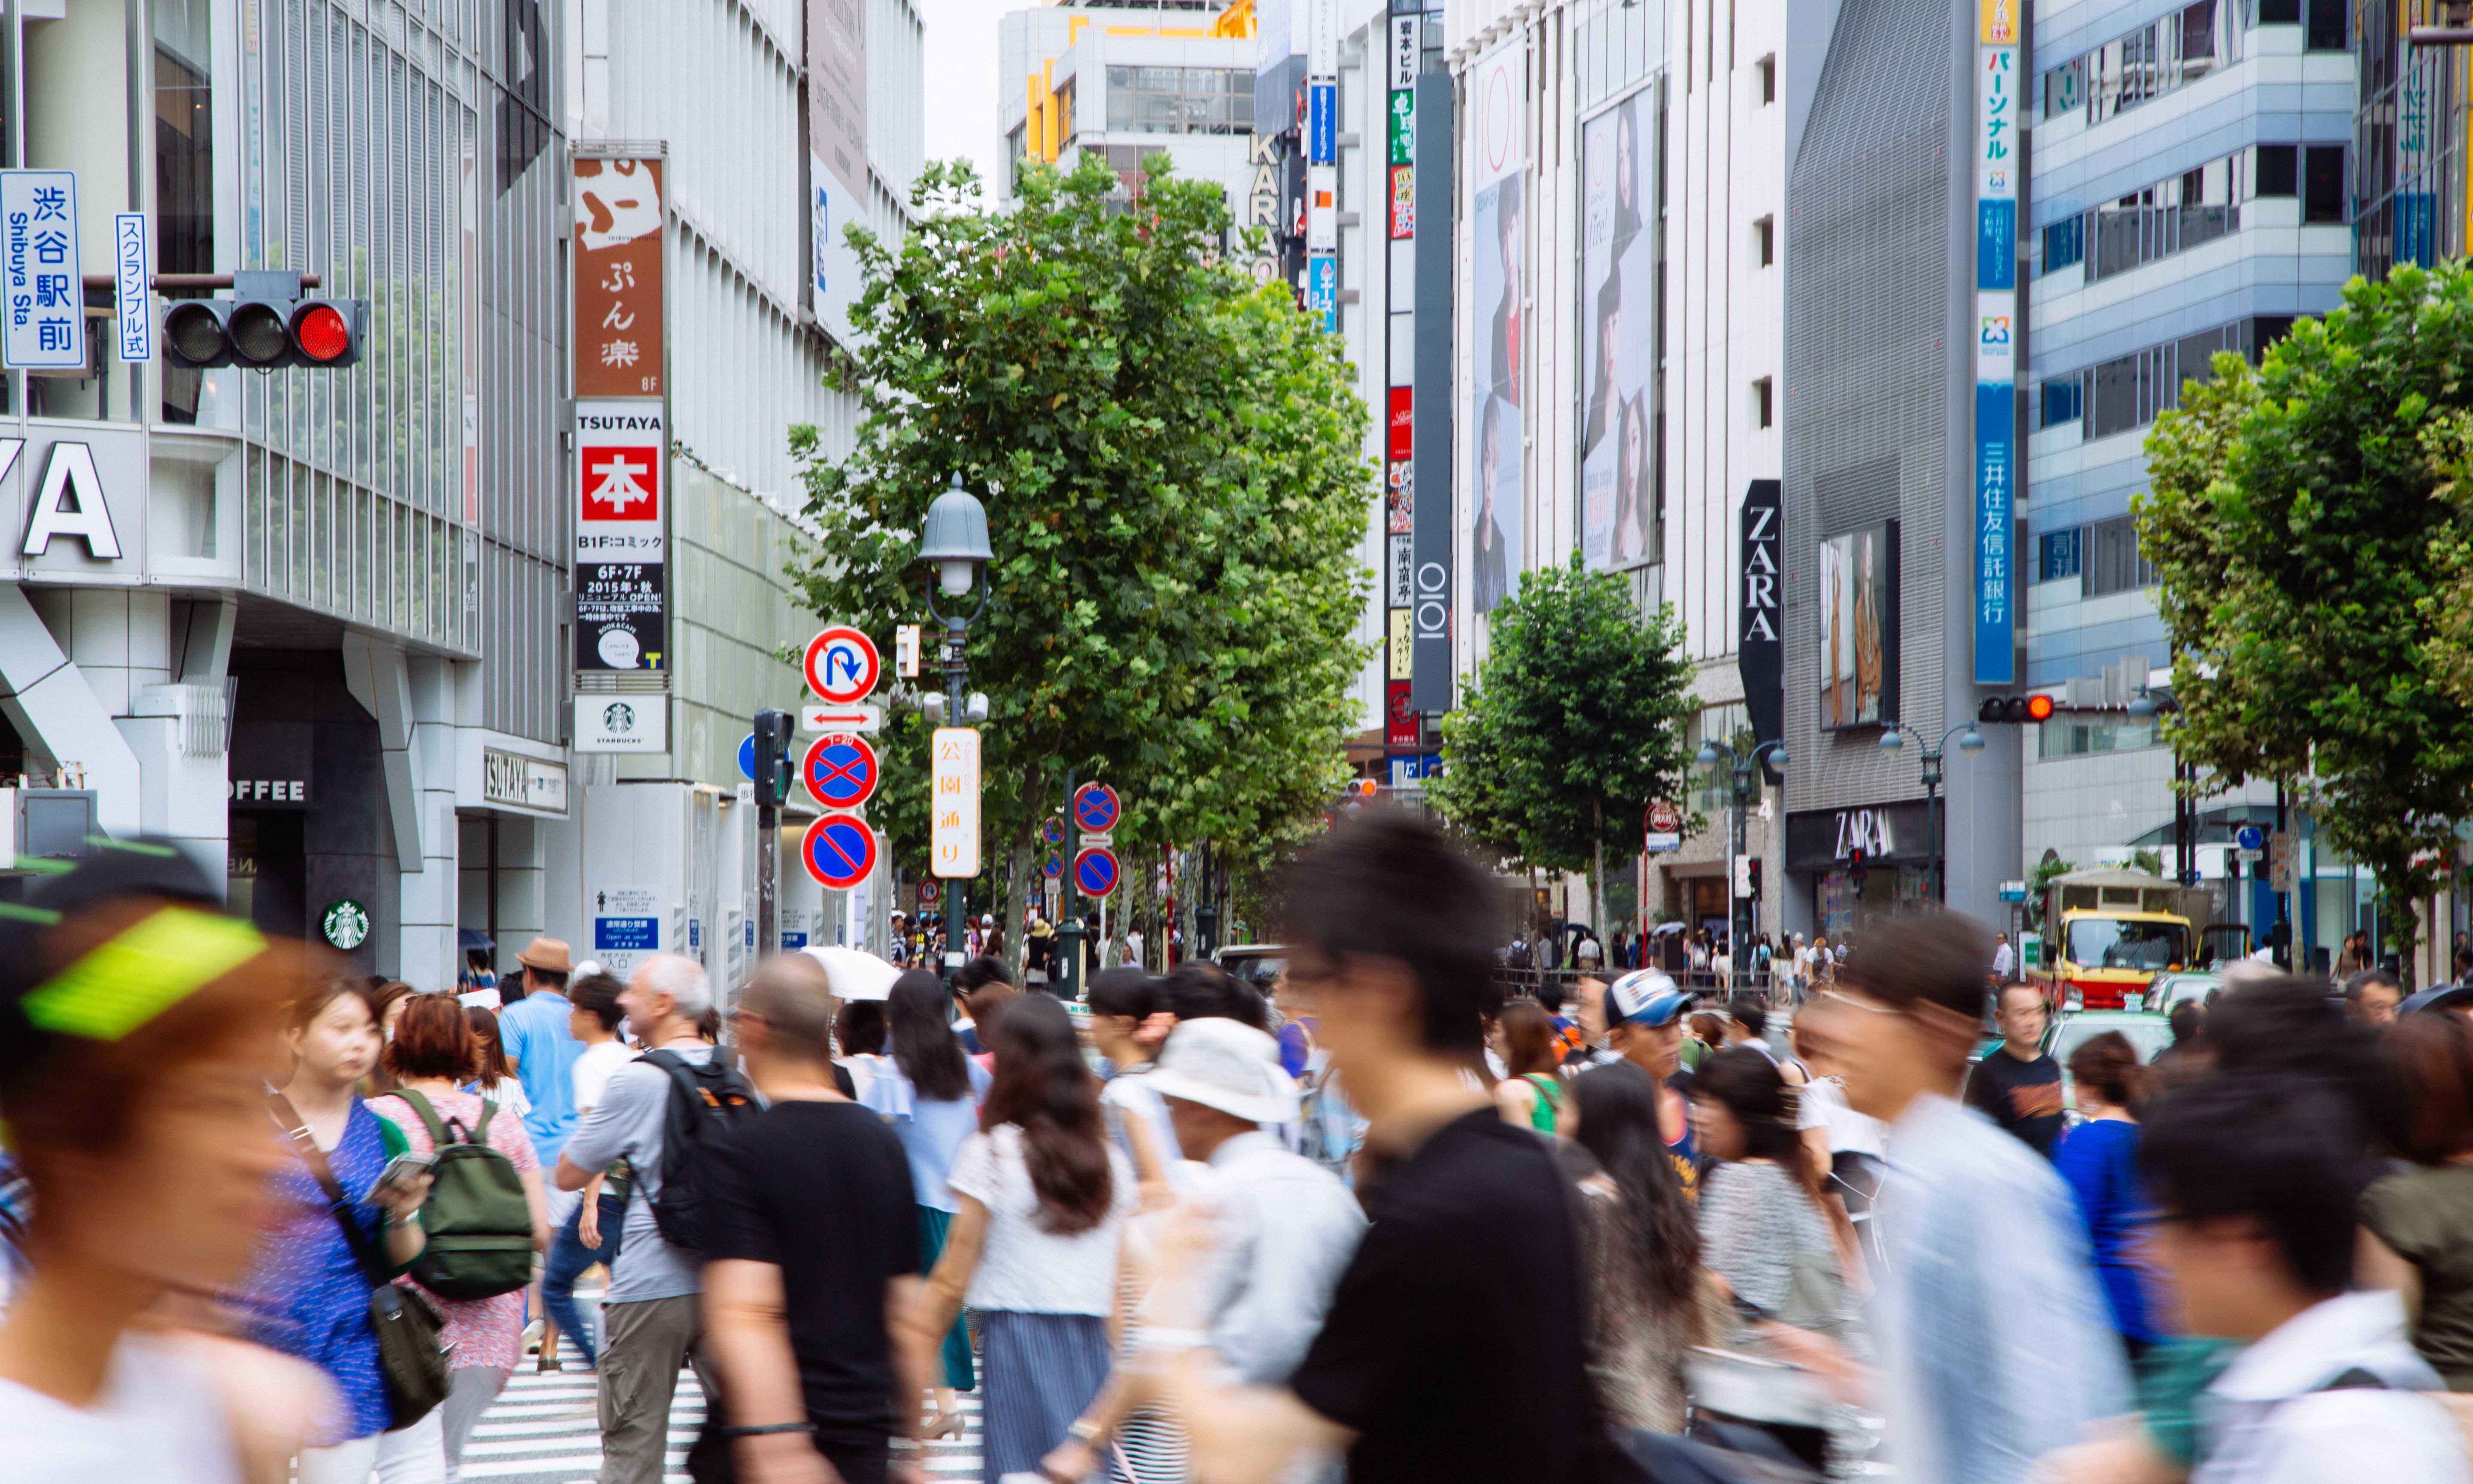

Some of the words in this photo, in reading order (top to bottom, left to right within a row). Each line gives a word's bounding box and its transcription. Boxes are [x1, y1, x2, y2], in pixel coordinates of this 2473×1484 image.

[1400, 20, 1413, 85] 岩本ビル
[1987, 52, 2009, 160] パーソナル
[9, 212, 28, 287] Shibuya
[33, 186, 72, 351] 渋谷駅前
[13, 296, 32, 333] Sta.
[122, 222, 144, 353] スクランブル式
[602, 261, 639, 368] ぷん楽
[578, 416, 661, 430] TSUTAYA
[590, 454, 649, 514] 本
[579, 536, 662, 548] B1F:コミック
[1983, 442, 2005, 623] 三井住友信託銀行
[629, 592, 662, 601] OPEN!
[1744, 507, 1778, 641] ZARA
[941, 741, 960, 864] 公園通り
[1835, 808, 1893, 859] ZARA
[607, 958, 627, 968] 入口
